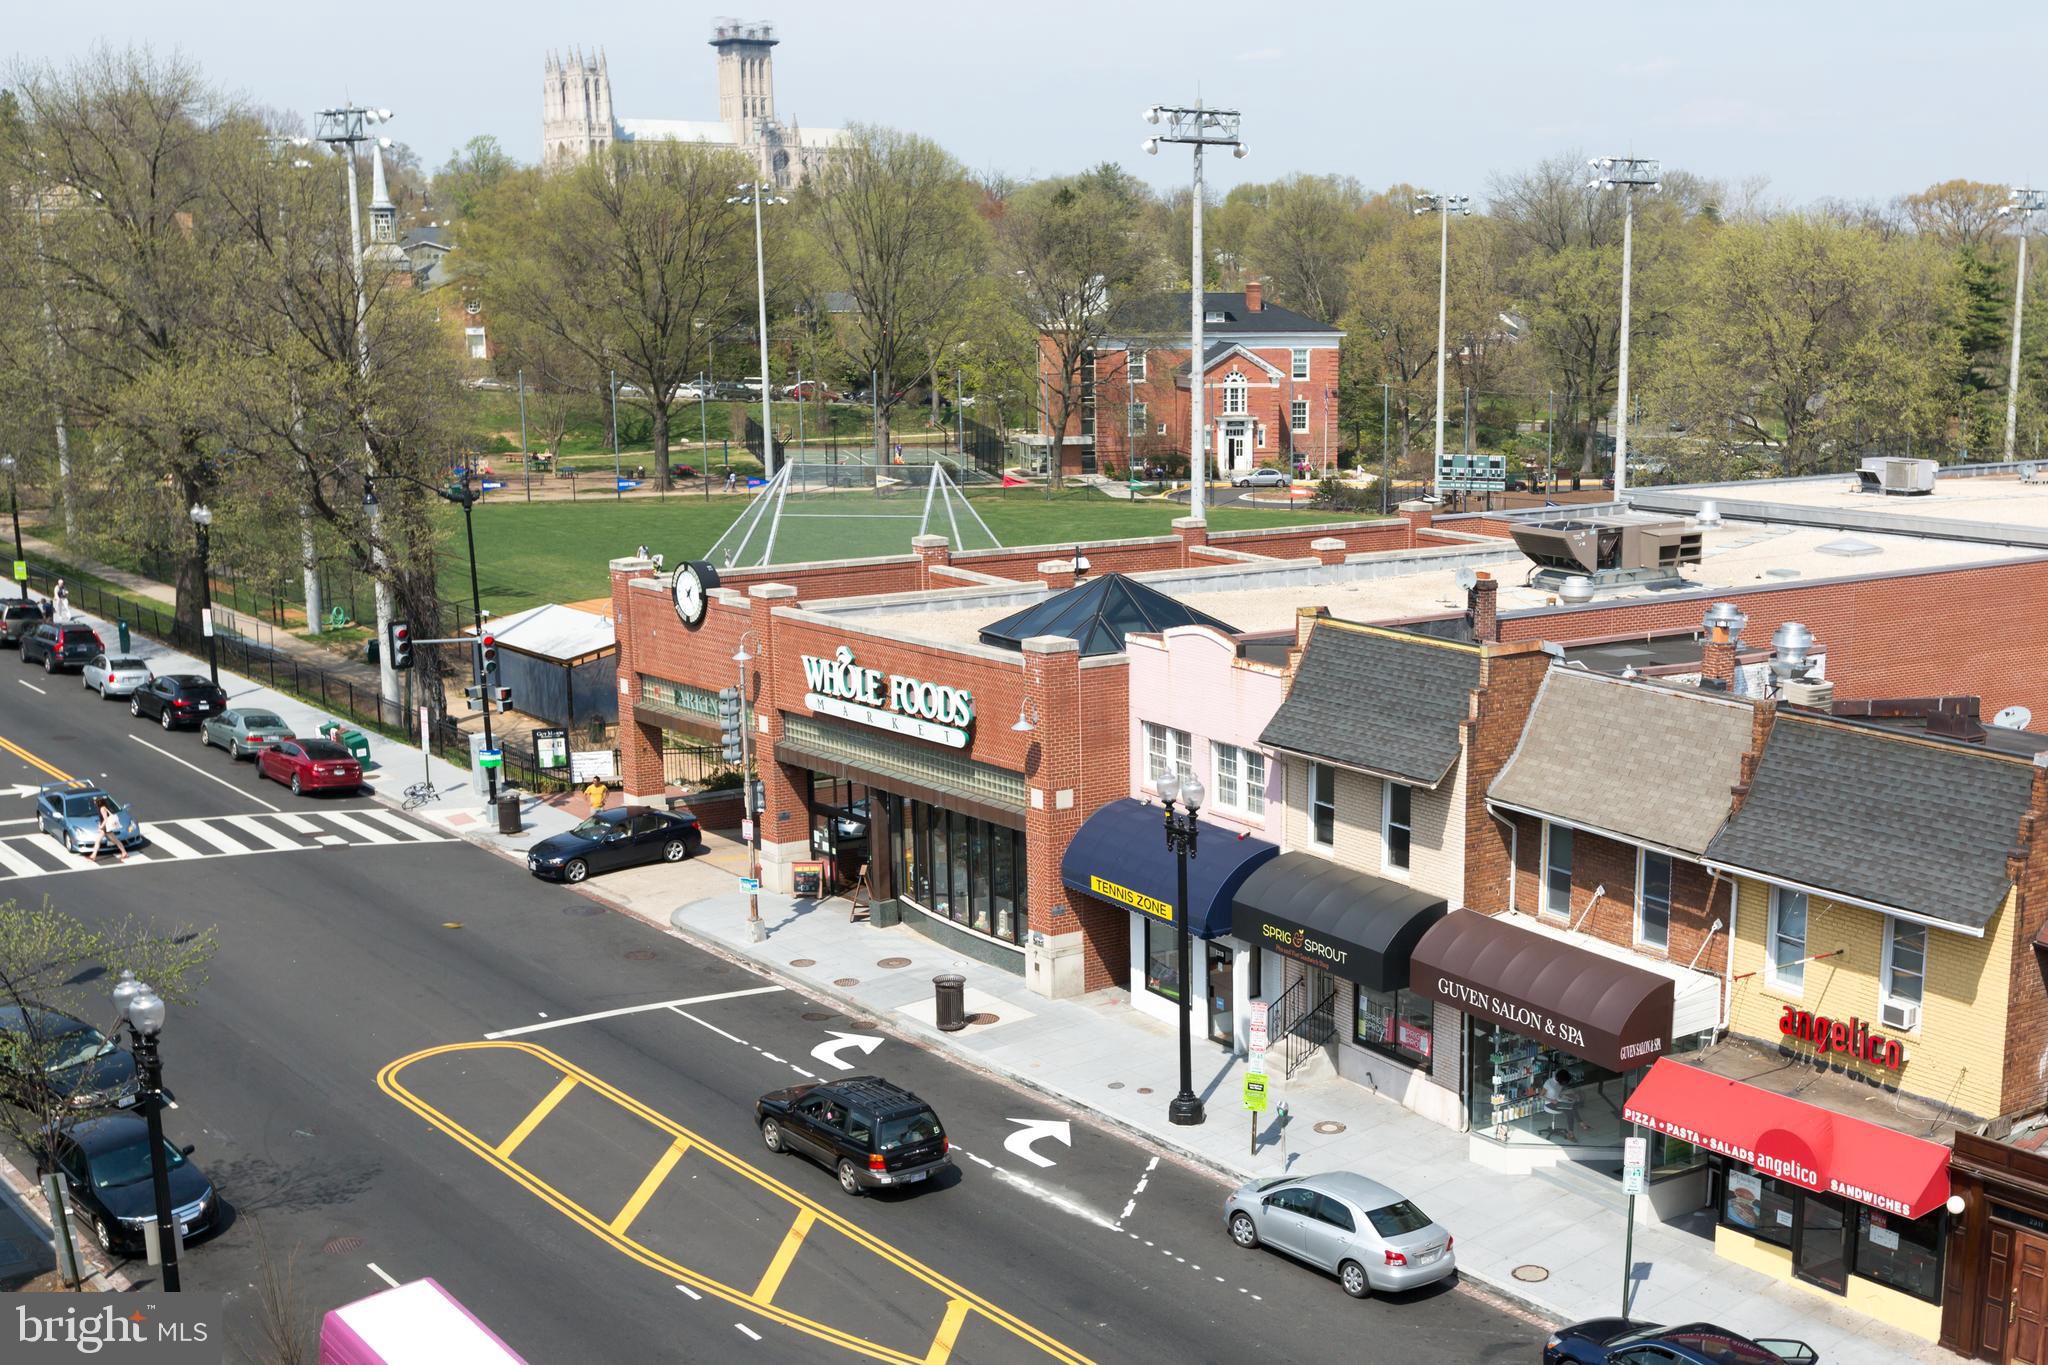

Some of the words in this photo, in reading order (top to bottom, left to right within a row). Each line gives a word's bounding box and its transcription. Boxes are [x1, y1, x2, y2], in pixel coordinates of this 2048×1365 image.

[801, 645, 884, 706] WHOLE
[889, 674, 974, 727] FOODS
[816, 697, 951, 744] MARKET
[1096, 879, 1134, 903] TENNIS
[1136, 895, 1167, 916] ZONE
[1262, 924, 1292, 944] SPRIG
[1304, 938, 1348, 964] SPROUT
[1438, 977, 1489, 1010] GUVEN
[1492, 997, 1542, 1030] SALON
[1545, 1018, 1556, 1036] &
[1559, 1023, 1585, 1047] SPA
[1621, 1044, 1636, 1060] GUVEN
[1636, 1040, 1650, 1056] SALON
[1779, 1005, 1902, 1070] angelico
[1624, 1108, 1657, 1128] PIZZA
[1666, 1122, 1700, 1143] PASTA
[1709, 1137, 1755, 1163] SALADS
[1757, 1153, 1817, 1185] angelico
[1830, 1179, 1911, 1216] SANDWICHES
